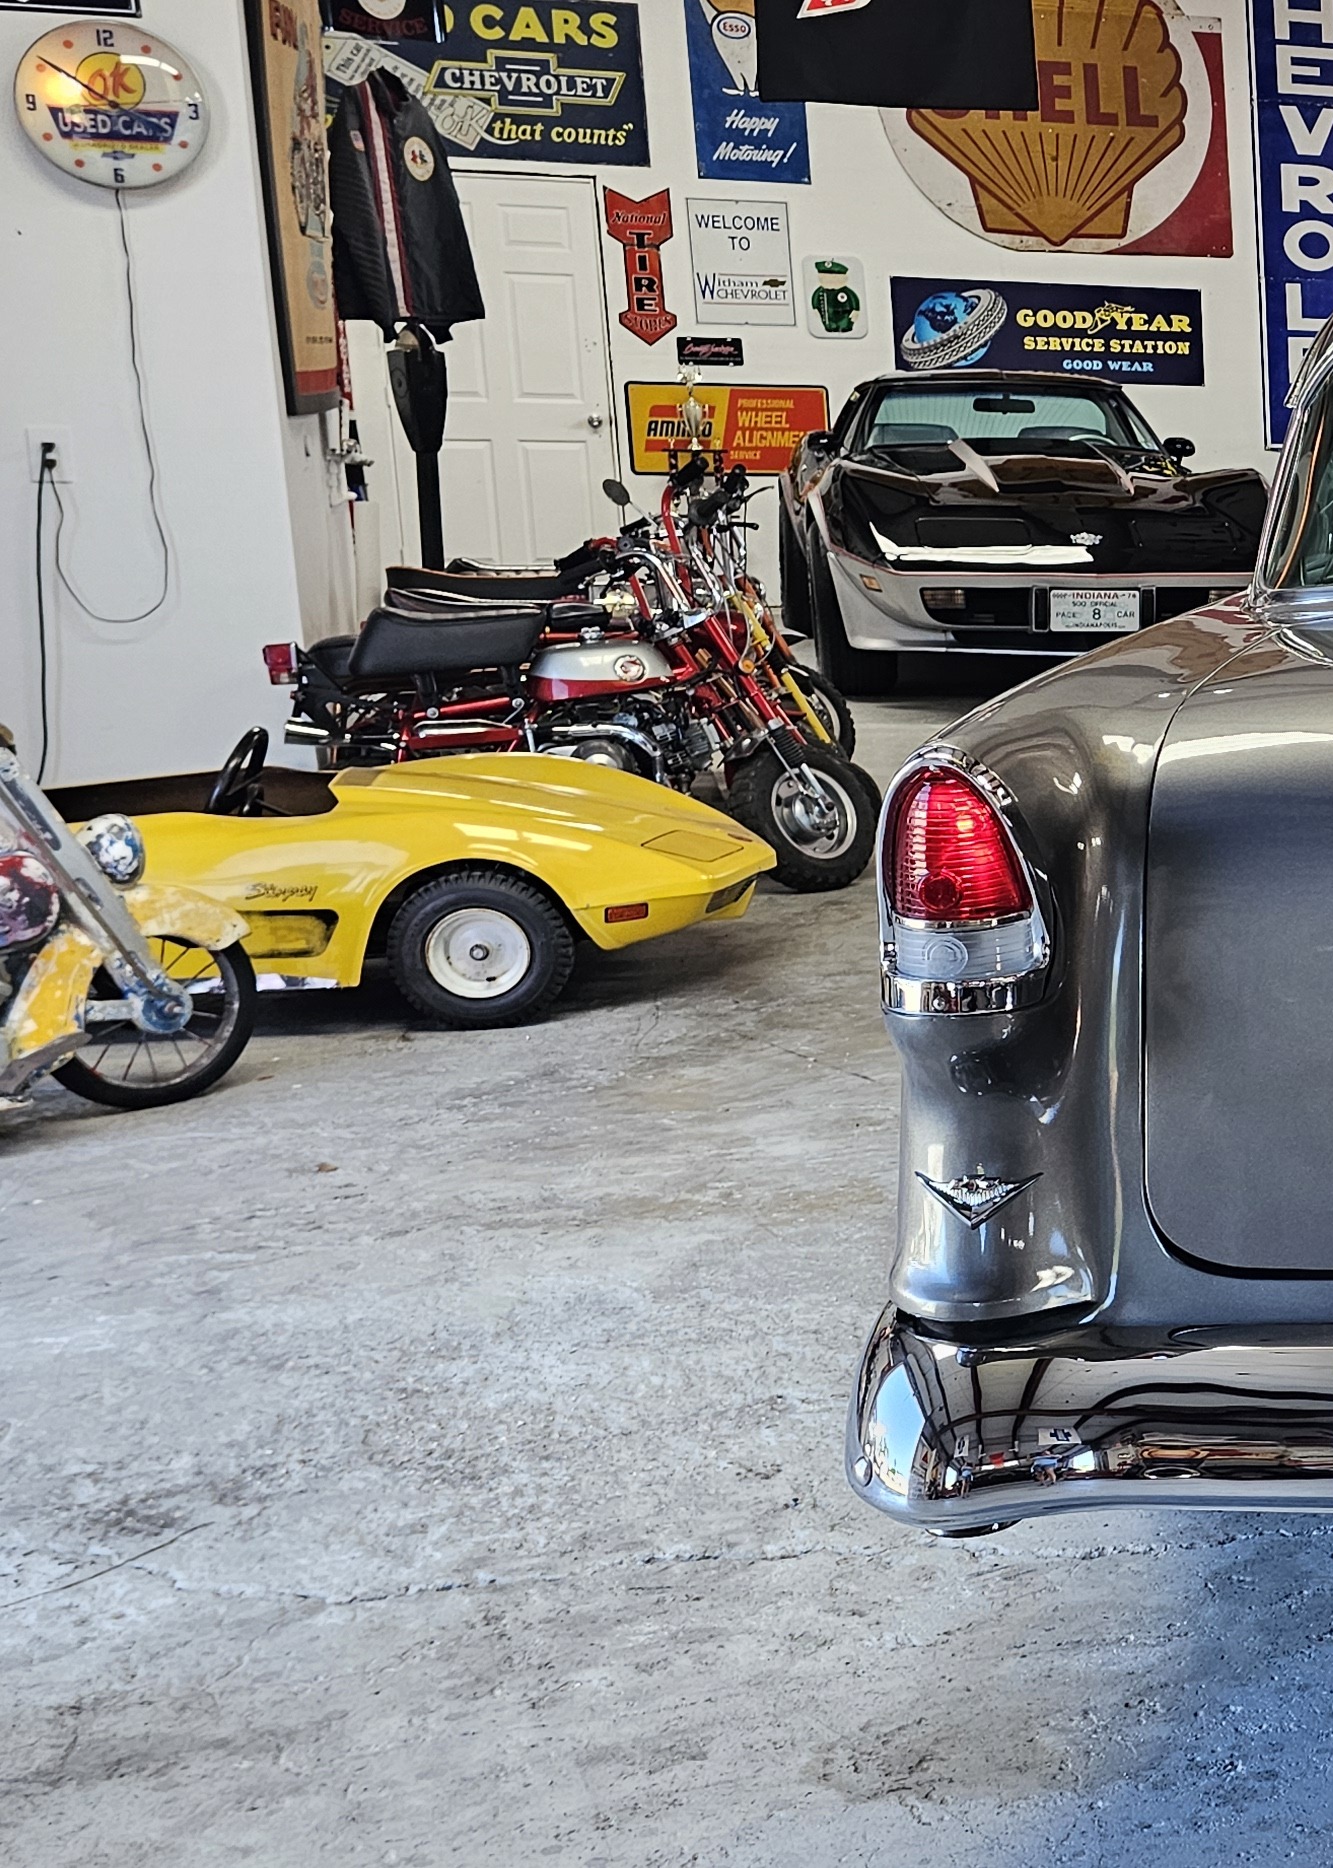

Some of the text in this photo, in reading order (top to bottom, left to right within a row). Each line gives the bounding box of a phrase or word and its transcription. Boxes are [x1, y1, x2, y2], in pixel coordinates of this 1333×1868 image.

[470, 3, 619, 49] CARS
[96, 29, 115, 48] 12
[444, 68, 608, 97] CHEVROLET
[25, 94, 37, 111] 9
[188, 103, 200, 120] 3
[58, 112, 172, 137] USED CAS
[492, 118, 544, 142] that
[725, 109, 780, 138] Happy
[713, 142, 798, 169] Motoring!
[113, 168, 125, 184] 6
[612, 210, 668, 227] National
[695, 214, 781, 232] WELCOME
[728, 236, 751, 251] TO
[627, 230, 660, 315] TIRE
[716, 288, 788, 301] CHEVROLET
[1024, 336, 1191, 355] SERVICE STATION
[1062, 359, 1154, 373] GOOD WEAR
[737, 398, 795, 410] PROFESSIONAL
[738, 411, 790, 428] WHEEL
[646, 420, 713, 438] AMMO
[729, 450, 762, 461] SERVICE
[1072, 592, 1119, 600] INDIANA
[1092, 607, 1102, 621] 8
[1116, 610, 1135, 618] CAR
